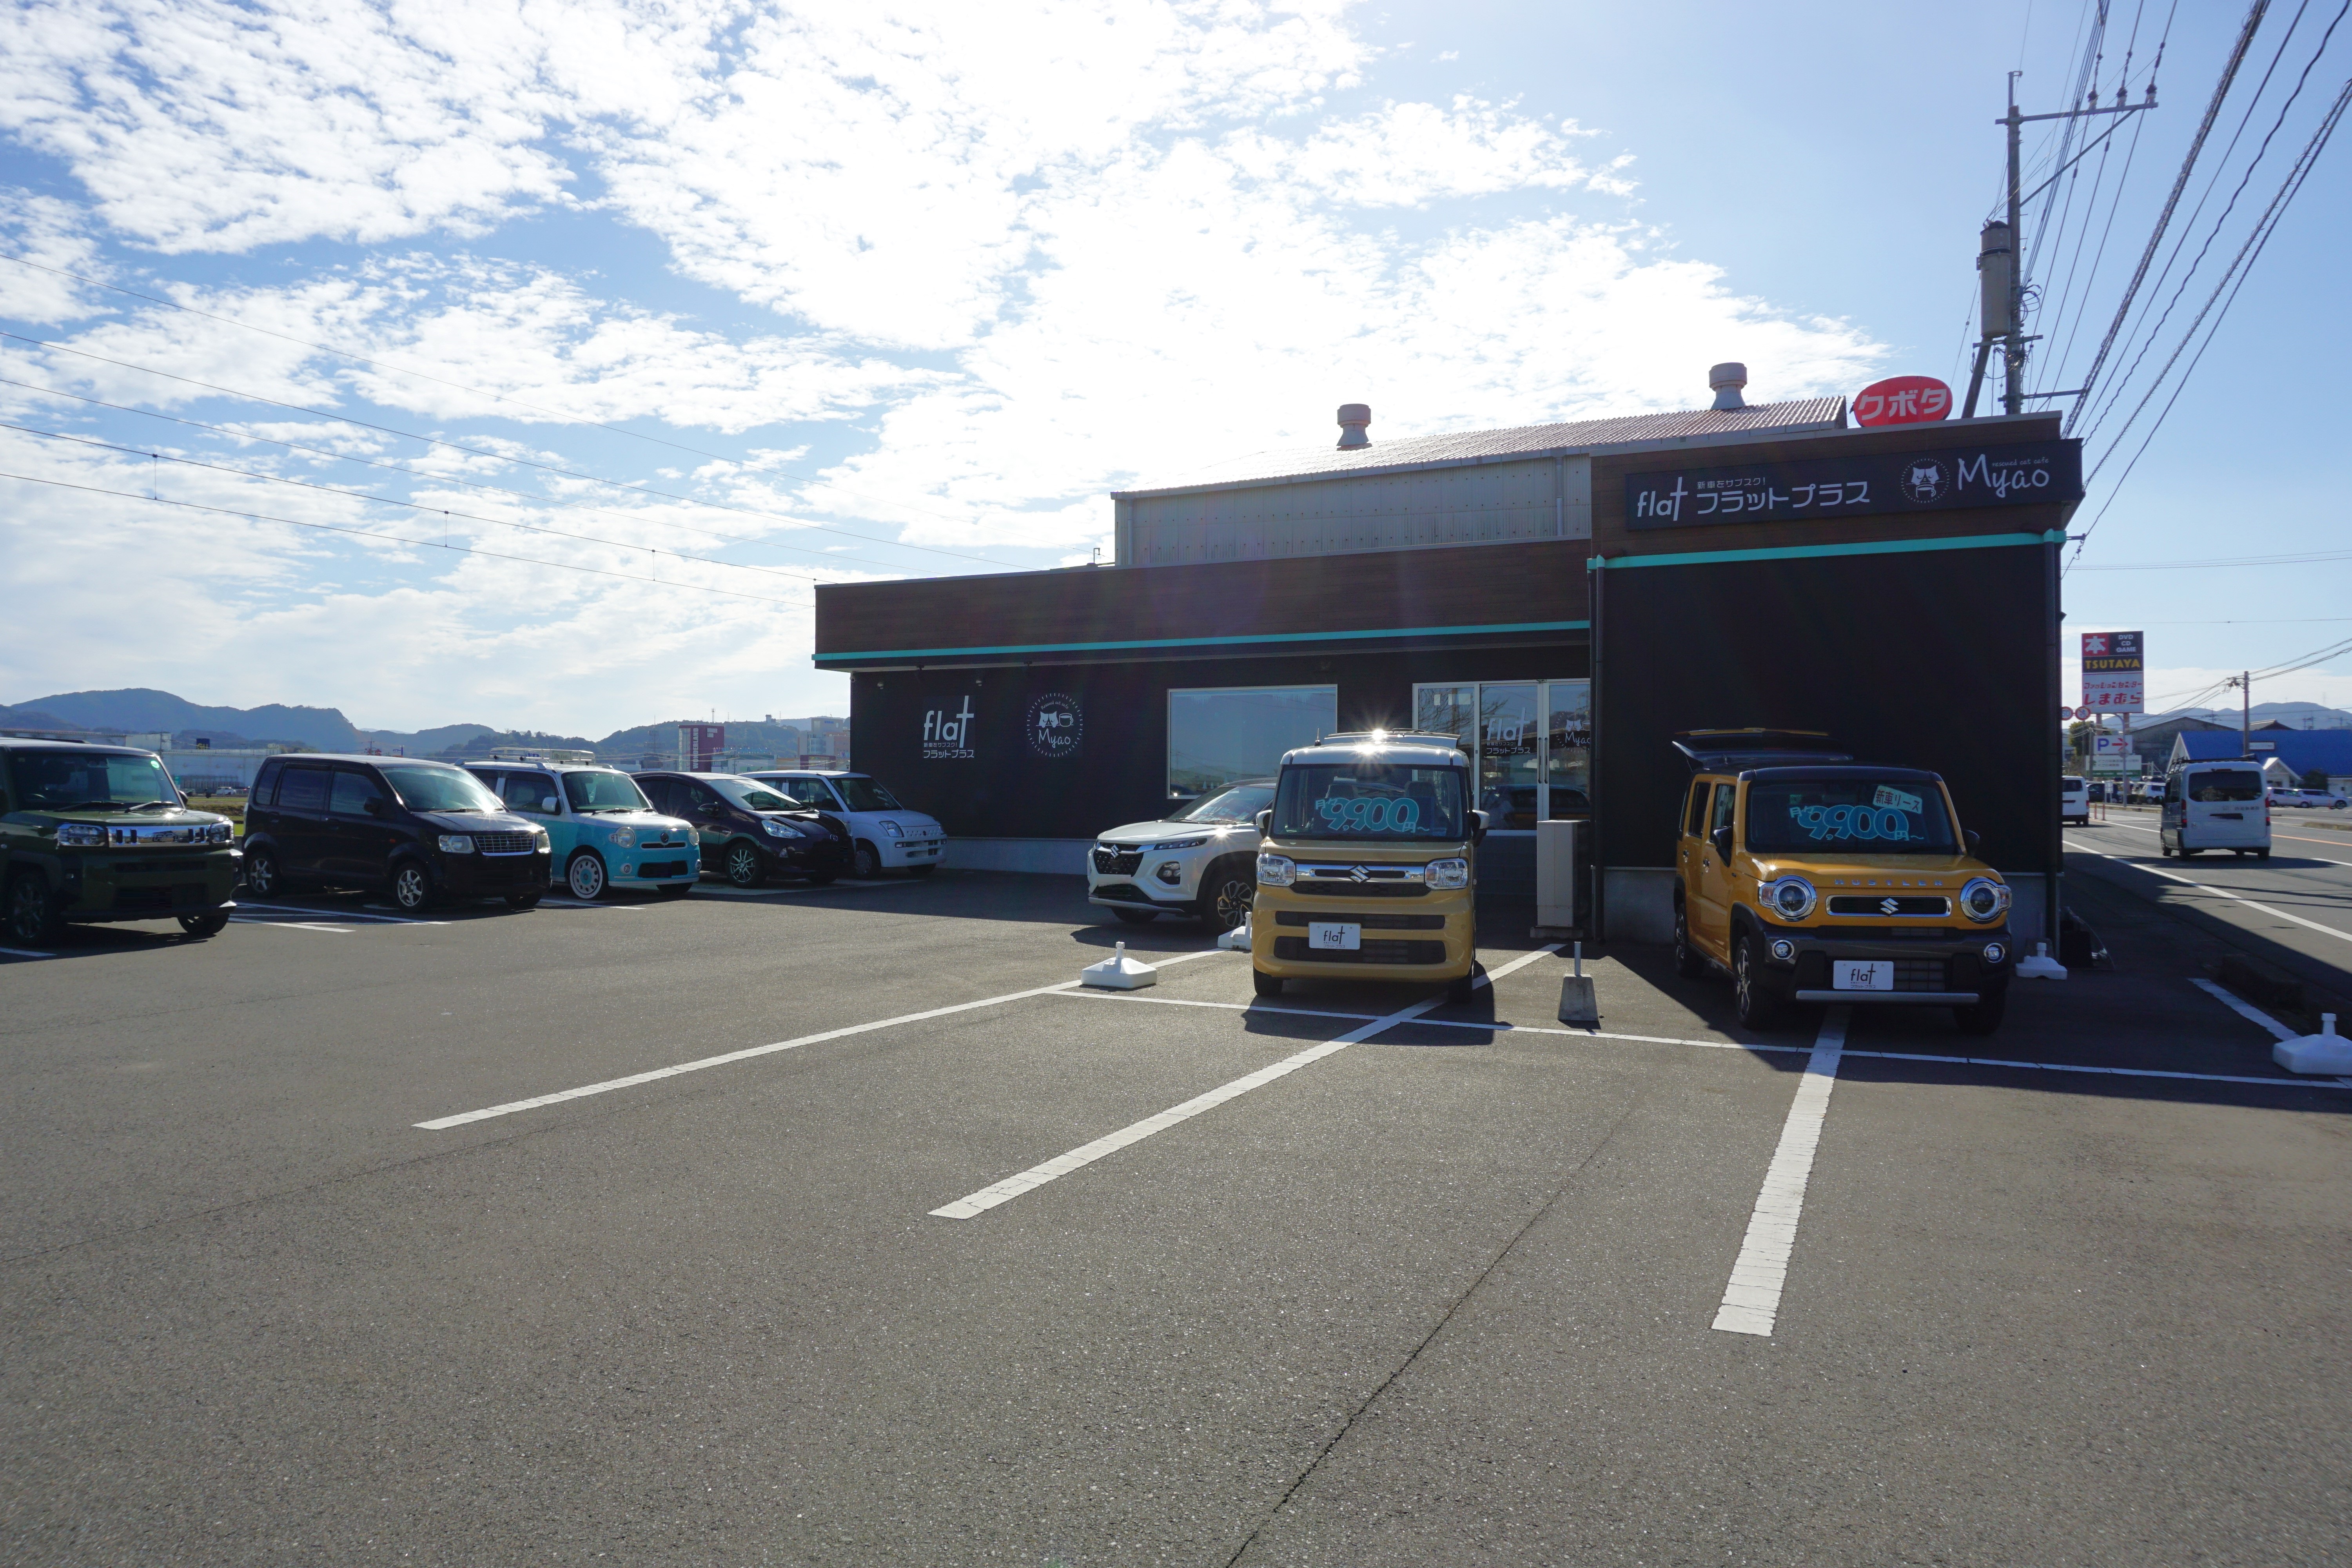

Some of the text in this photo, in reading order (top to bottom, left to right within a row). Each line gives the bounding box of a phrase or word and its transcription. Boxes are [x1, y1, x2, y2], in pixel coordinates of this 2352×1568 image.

[1856, 387, 1948, 421] クボタ
[1992, 459, 2017, 467] rescued
[1697, 477, 1766, 489] 新車をサブスク!
[1958, 454, 2049, 498] Myao
[1637, 475, 1688, 521] flat
[1697, 481, 1871, 515] フラットプラス
[2085, 635, 2105, 654] 本
[2085, 659, 2140, 669] TSUTAYA
[2084, 681, 2142, 689] ファッションセンター
[2084, 692, 2142, 705] しまむら
[924, 695, 974, 748] flat
[1486, 707, 1530, 746] flat
[1038, 728, 1071, 748] Myao
[2098, 738, 2109, 751] P
[923, 749, 974, 758] フラットプラス
[1876, 790, 1920, 811] 新車リース
[1323, 926, 1345, 945] flat
[1851, 963, 1876, 984] flat
